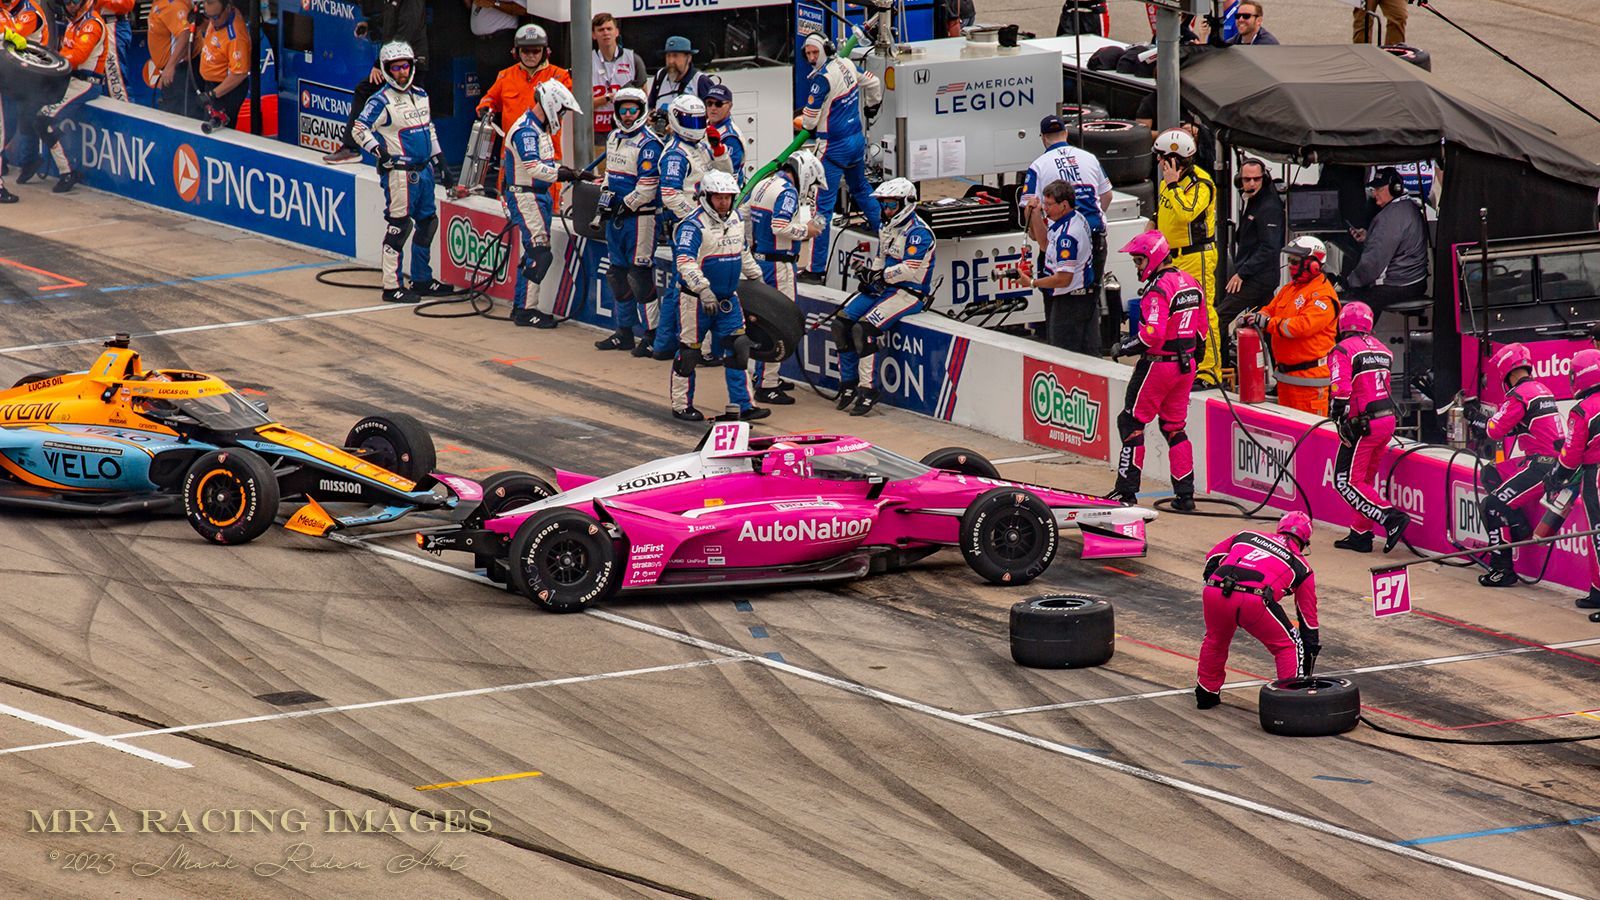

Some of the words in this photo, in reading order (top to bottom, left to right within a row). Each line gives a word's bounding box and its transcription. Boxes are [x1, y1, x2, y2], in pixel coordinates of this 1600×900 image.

[965, 76, 1034, 91] AMERICAN
[311, 93, 352, 116] PNCBAN
[936, 88, 1035, 115] LEGION
[301, 134, 342, 151] RACIN
[311, 118, 345, 140] GANAS
[1059, 166, 1082, 182] ONE
[204, 156, 347, 236] PNCBANK
[952, 259, 990, 304] BE
[868, 310, 884, 325] NE
[877, 332, 924, 356] RICAN
[105, 353, 118, 376] 7
[803, 335, 924, 402] LEON
[28, 379, 51, 392] LUCAS
[51, 377, 64, 386] OIL
[1032, 373, 1097, 434] O'Reilly
[353, 421, 388, 433] Firestone
[714, 424, 740, 451] 27
[1049, 429, 1065, 442] AUTO
[1065, 432, 1082, 447] PARTS
[43, 451, 122, 480] VELO
[1239, 438, 1260, 475] DRV
[616, 470, 693, 492] HONDA
[1322, 458, 1425, 514] Aation
[184, 473, 195, 517] Firestone
[248, 478, 257, 521] Firestone
[737, 516, 873, 543] AutoNation
[970, 512, 988, 557] Firestone
[1043, 518, 1055, 563] Firestone
[526, 522, 560, 565] Firestone
[631, 543, 664, 554] UniFirst
[1251, 536, 1291, 561] AutoNation
[580, 560, 613, 603] Firestone
[1375, 573, 1407, 612] 27
